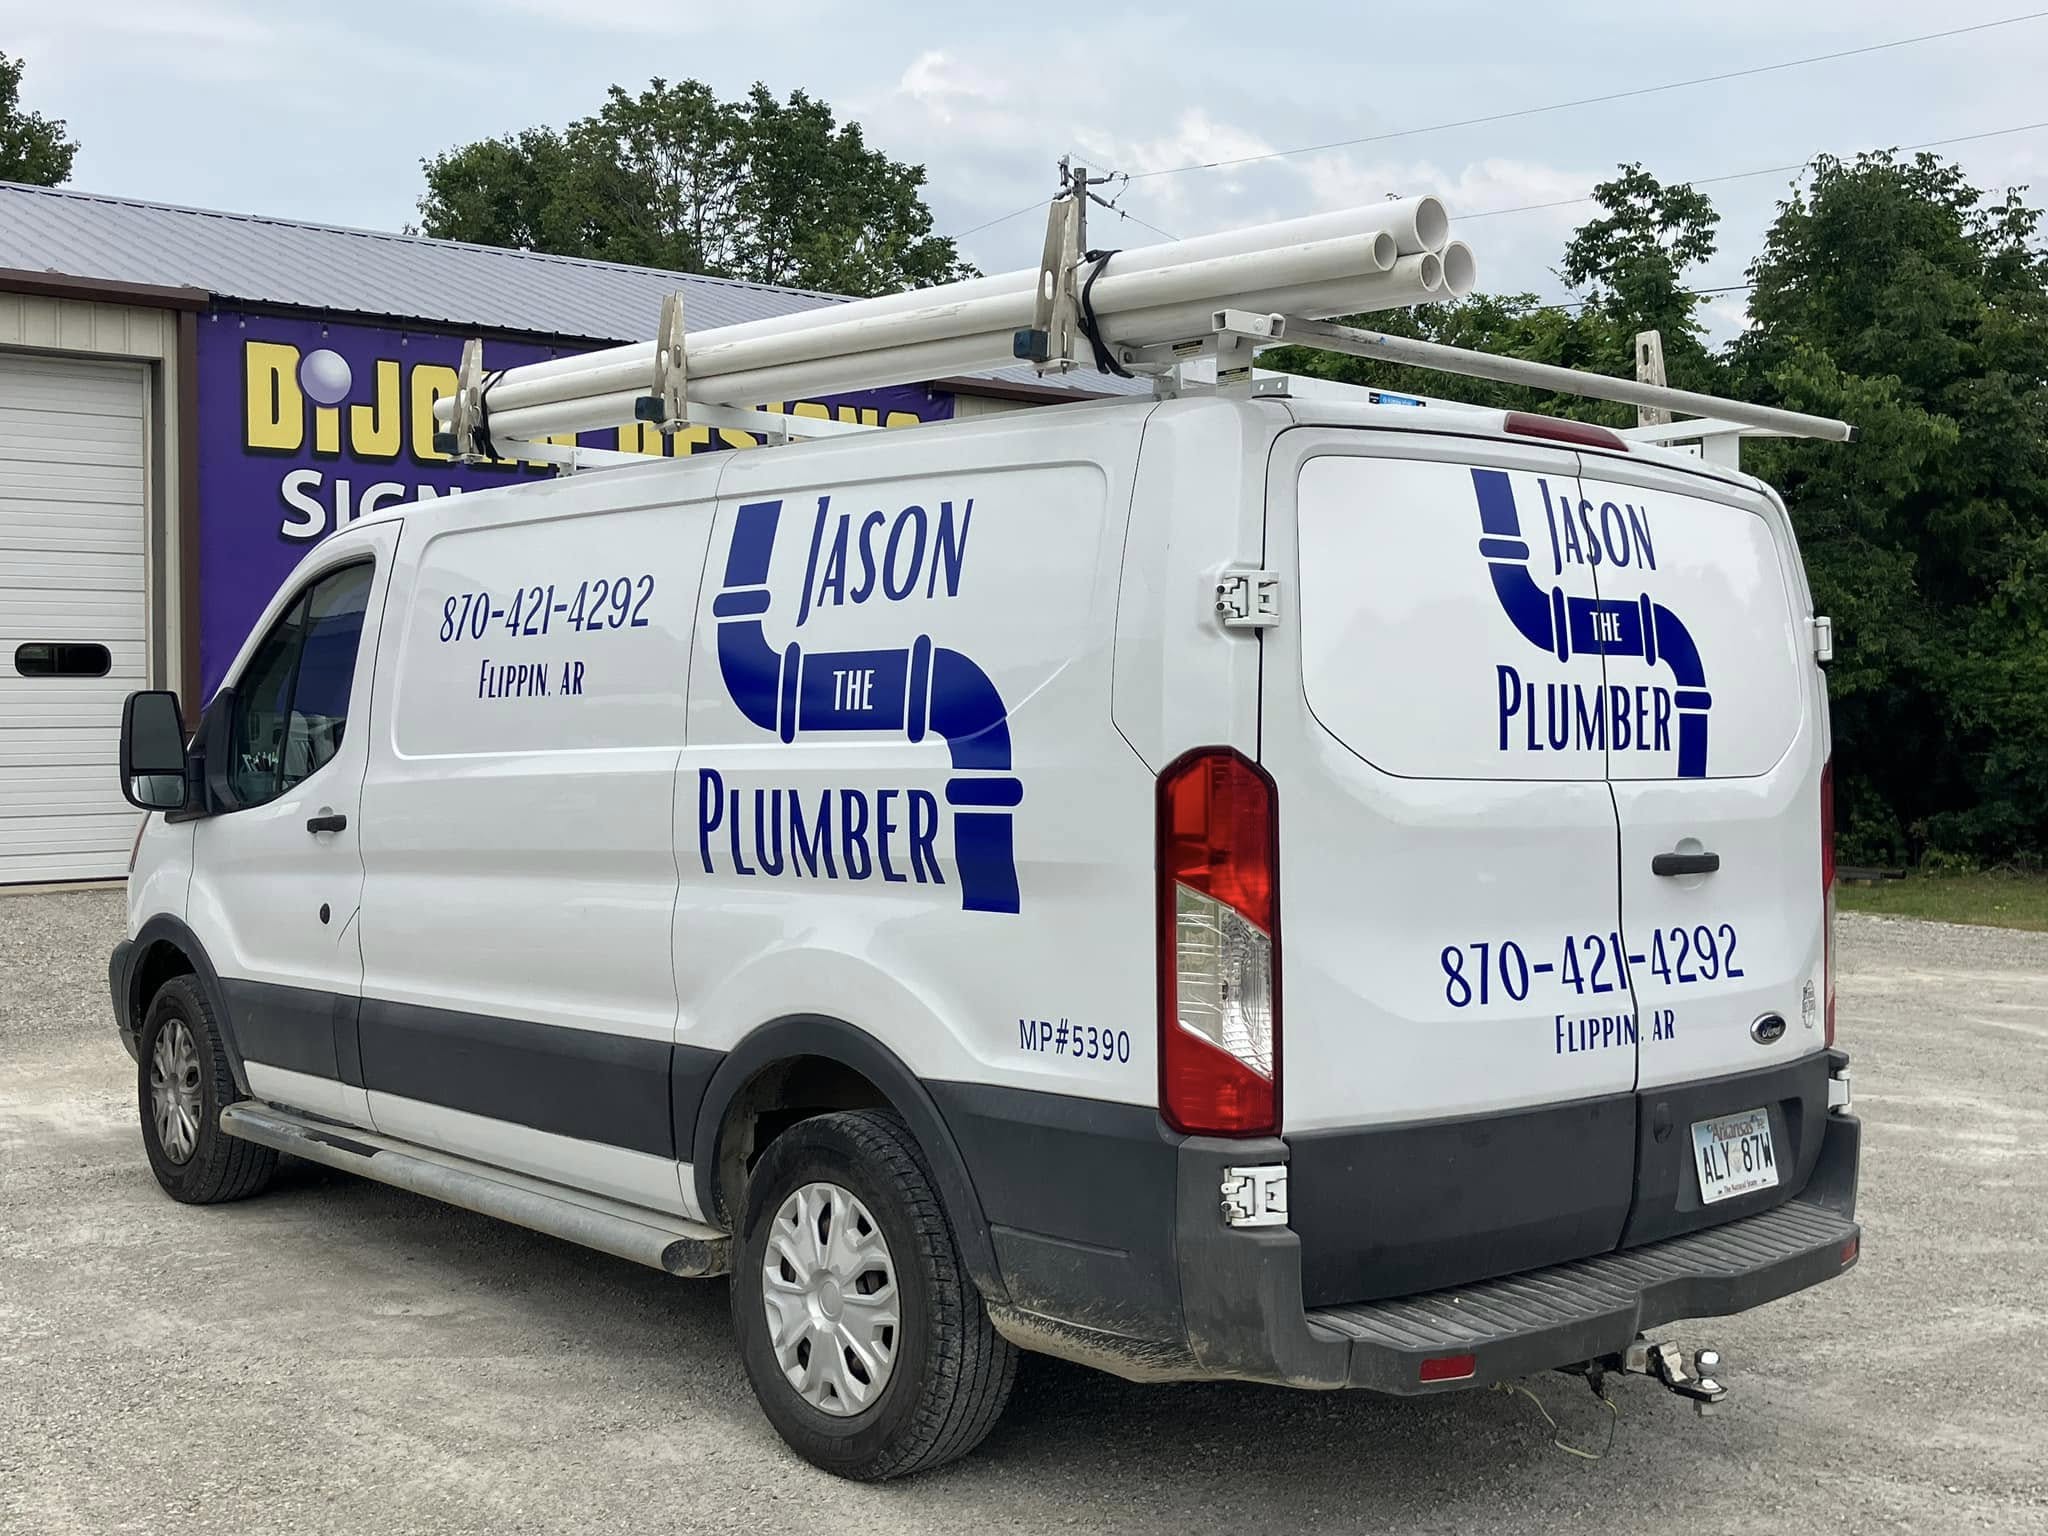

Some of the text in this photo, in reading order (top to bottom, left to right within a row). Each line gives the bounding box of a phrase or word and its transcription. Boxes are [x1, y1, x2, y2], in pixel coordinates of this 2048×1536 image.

[1537, 478, 1657, 576] JASON
[796, 496, 974, 627] JASON
[439, 575, 655, 642] 870-421-4292
[1589, 611, 1623, 642] THE
[560, 661, 585, 695] AR
[833, 669, 875, 711] THE
[1497, 665, 1671, 752] PLUMBER
[699, 767, 946, 885] PLUMBER
[1440, 924, 1745, 1008] 870-421-4292
[1019, 1018, 1130, 1064] MP#5390
[1652, 1009, 1675, 1042] AR
[1712, 1120, 1754, 1143] Arkansas
[1703, 1132, 1773, 1185] ALY 87W
